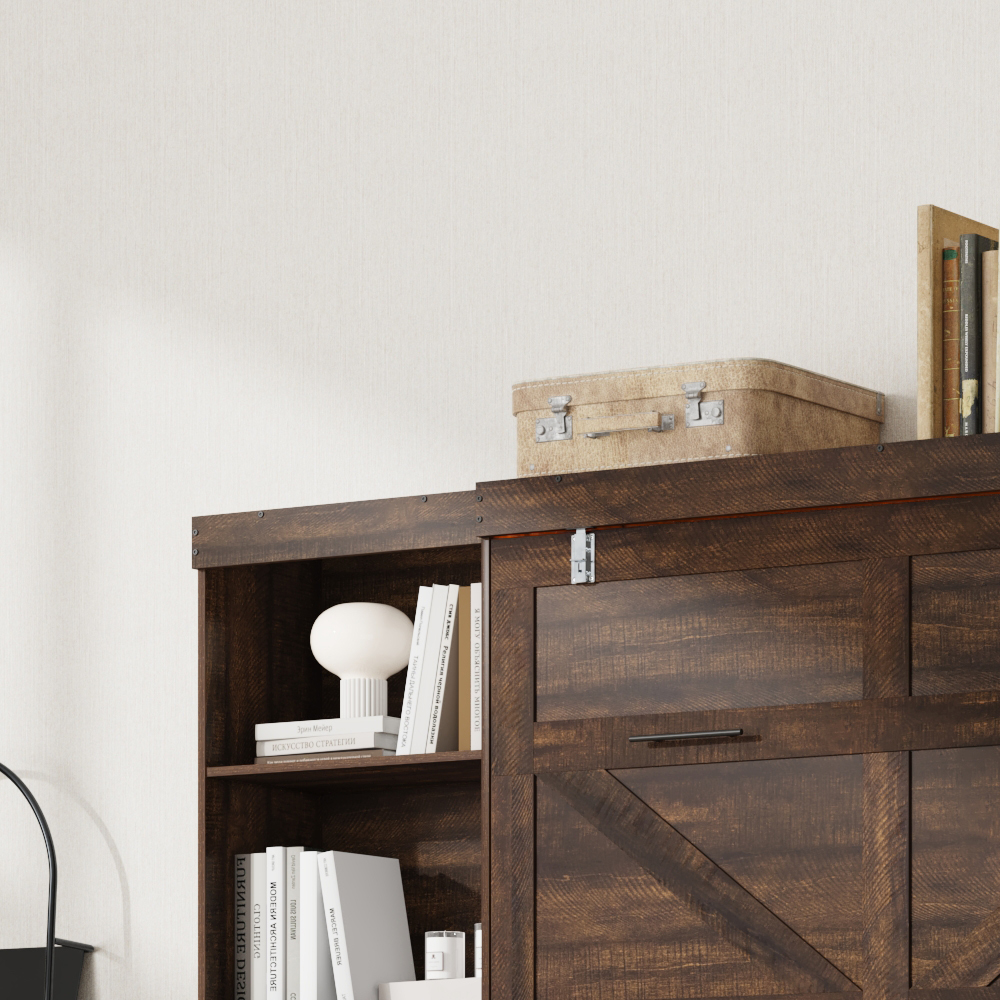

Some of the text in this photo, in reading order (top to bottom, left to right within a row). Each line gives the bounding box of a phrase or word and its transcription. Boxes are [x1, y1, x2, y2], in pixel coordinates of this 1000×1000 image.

[438, 645, 449, 676] Религия
[405, 680, 415, 715] ДАЛЬНЕГО
[297, 723, 333, 734] Эрин Мейер
[401, 716, 410, 748] ВОСТОКА
[429, 705, 439, 745] водолазки
[272, 737, 356, 752] ИСКУССТВО СТРАТЕГИИ
